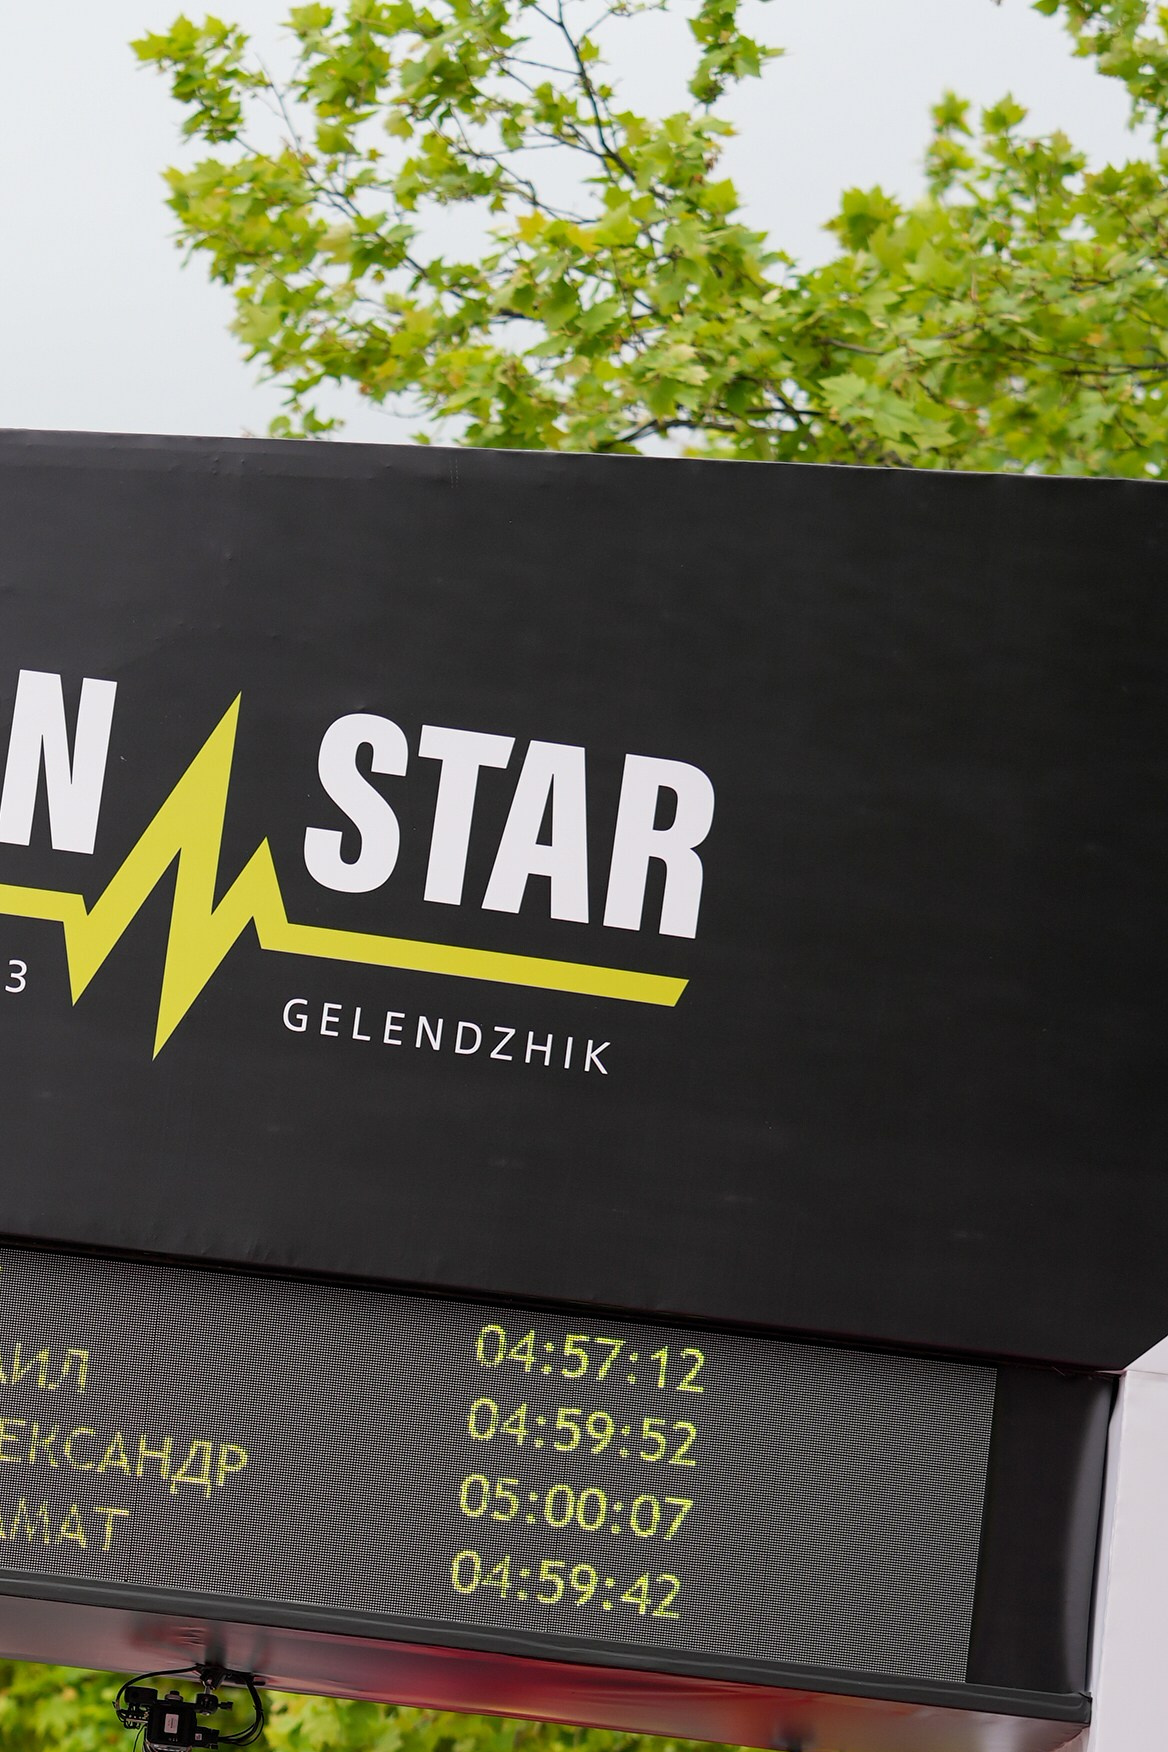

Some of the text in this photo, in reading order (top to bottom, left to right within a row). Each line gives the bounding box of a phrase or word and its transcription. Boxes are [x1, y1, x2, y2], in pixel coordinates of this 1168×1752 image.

[304, 712, 716, 939] STAR
[282, 997, 611, 1076] GELENDZHIK
[474, 1324, 705, 1393] 04:57:12
[466, 1397, 698, 1467] 04:59:52
[458, 1473, 694, 1541] 05:00:07
[450, 1549, 682, 1618] 04:59:42
